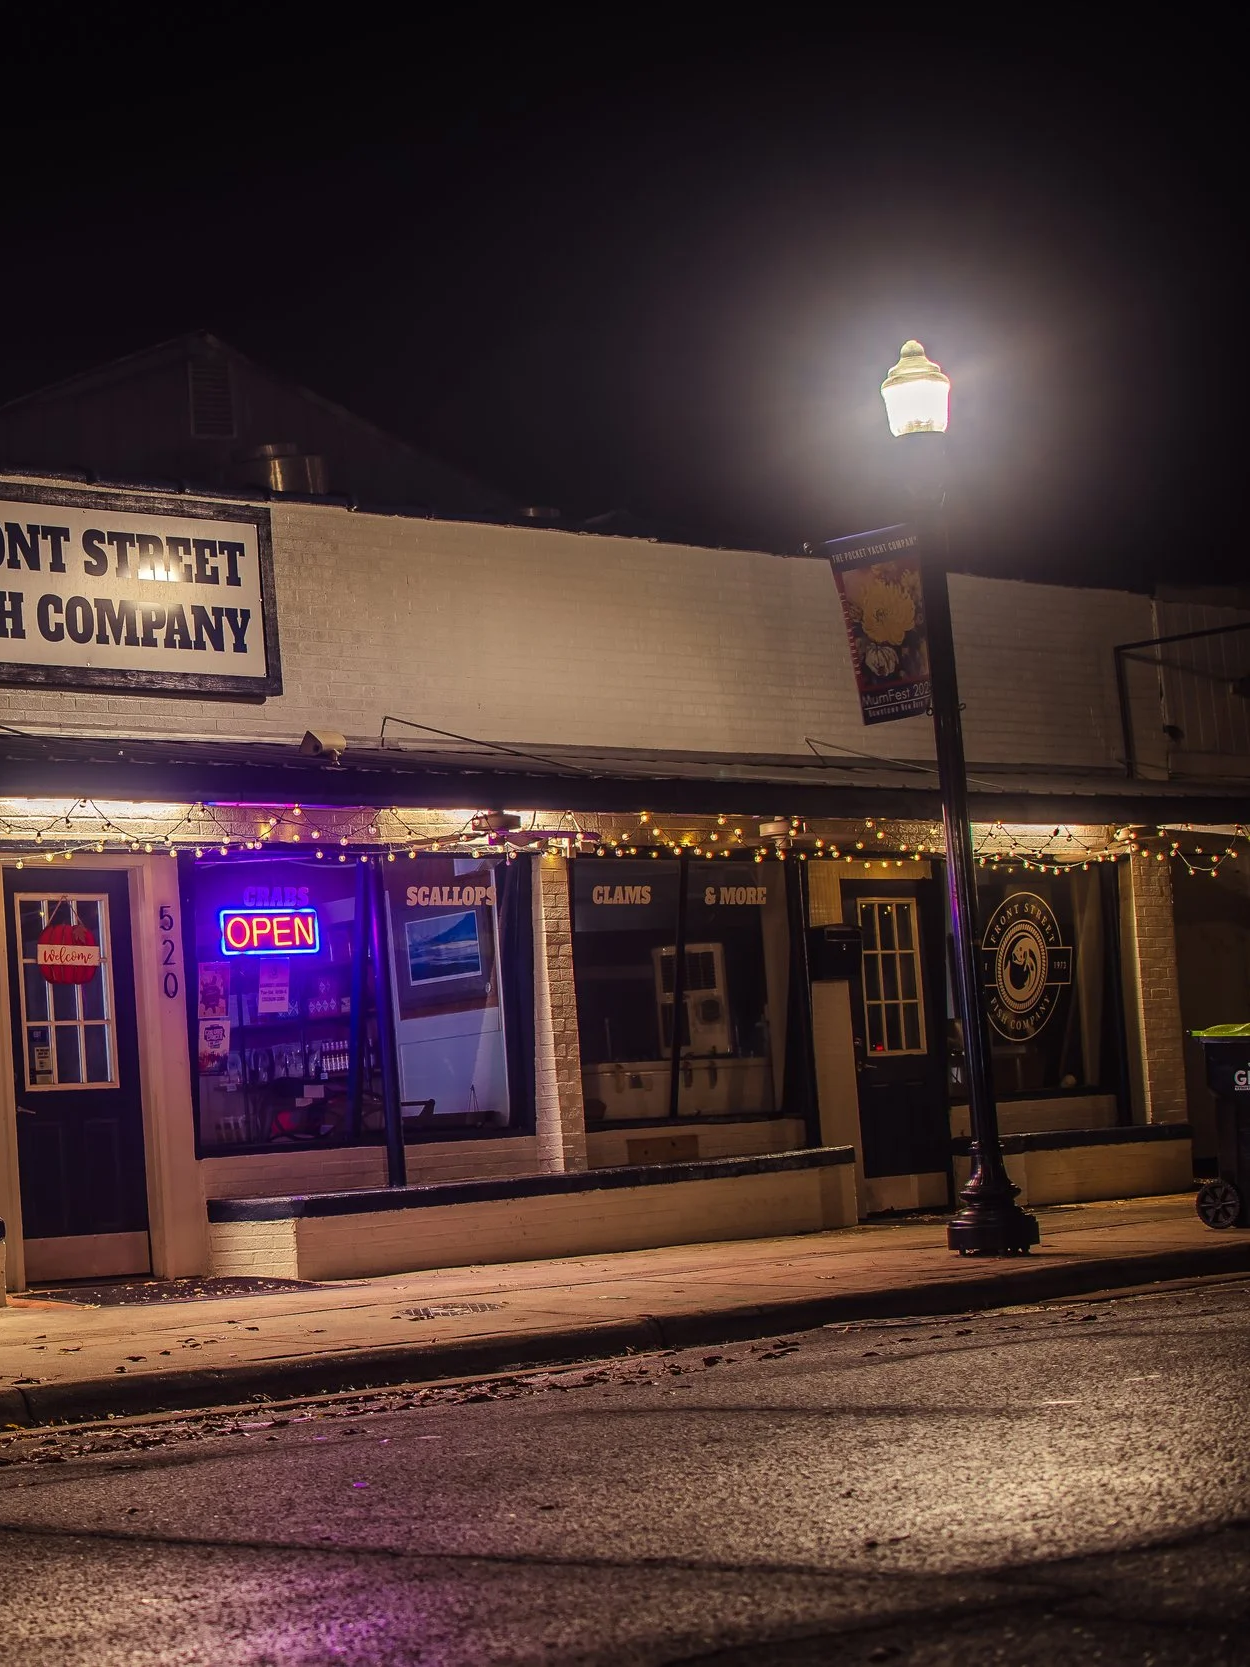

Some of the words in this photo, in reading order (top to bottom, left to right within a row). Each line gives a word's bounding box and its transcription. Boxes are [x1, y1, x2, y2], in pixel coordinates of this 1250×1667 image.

[82, 528, 245, 587] STREET
[832, 554, 844, 563] THE
[844, 548, 867, 561] POCKET
[868, 543, 887, 555] YACHT
[36, 594, 251, 653] COMPANY
[862, 688, 911, 707] MumFest
[913, 681, 932, 696] 202
[243, 886, 309, 907] CRABS
[406, 886, 496, 906] SCALLOPS
[592, 886, 651, 904] CLAMS
[705, 887, 716, 905] &
[719, 887, 767, 905] MORE
[226, 917, 313, 948] OPEN
[990, 904, 1020, 944] FRONT
[1023, 902, 1056, 943] STREET
[990, 996, 1008, 1026] FISH
[1010, 996, 1051, 1031] COMPANY
